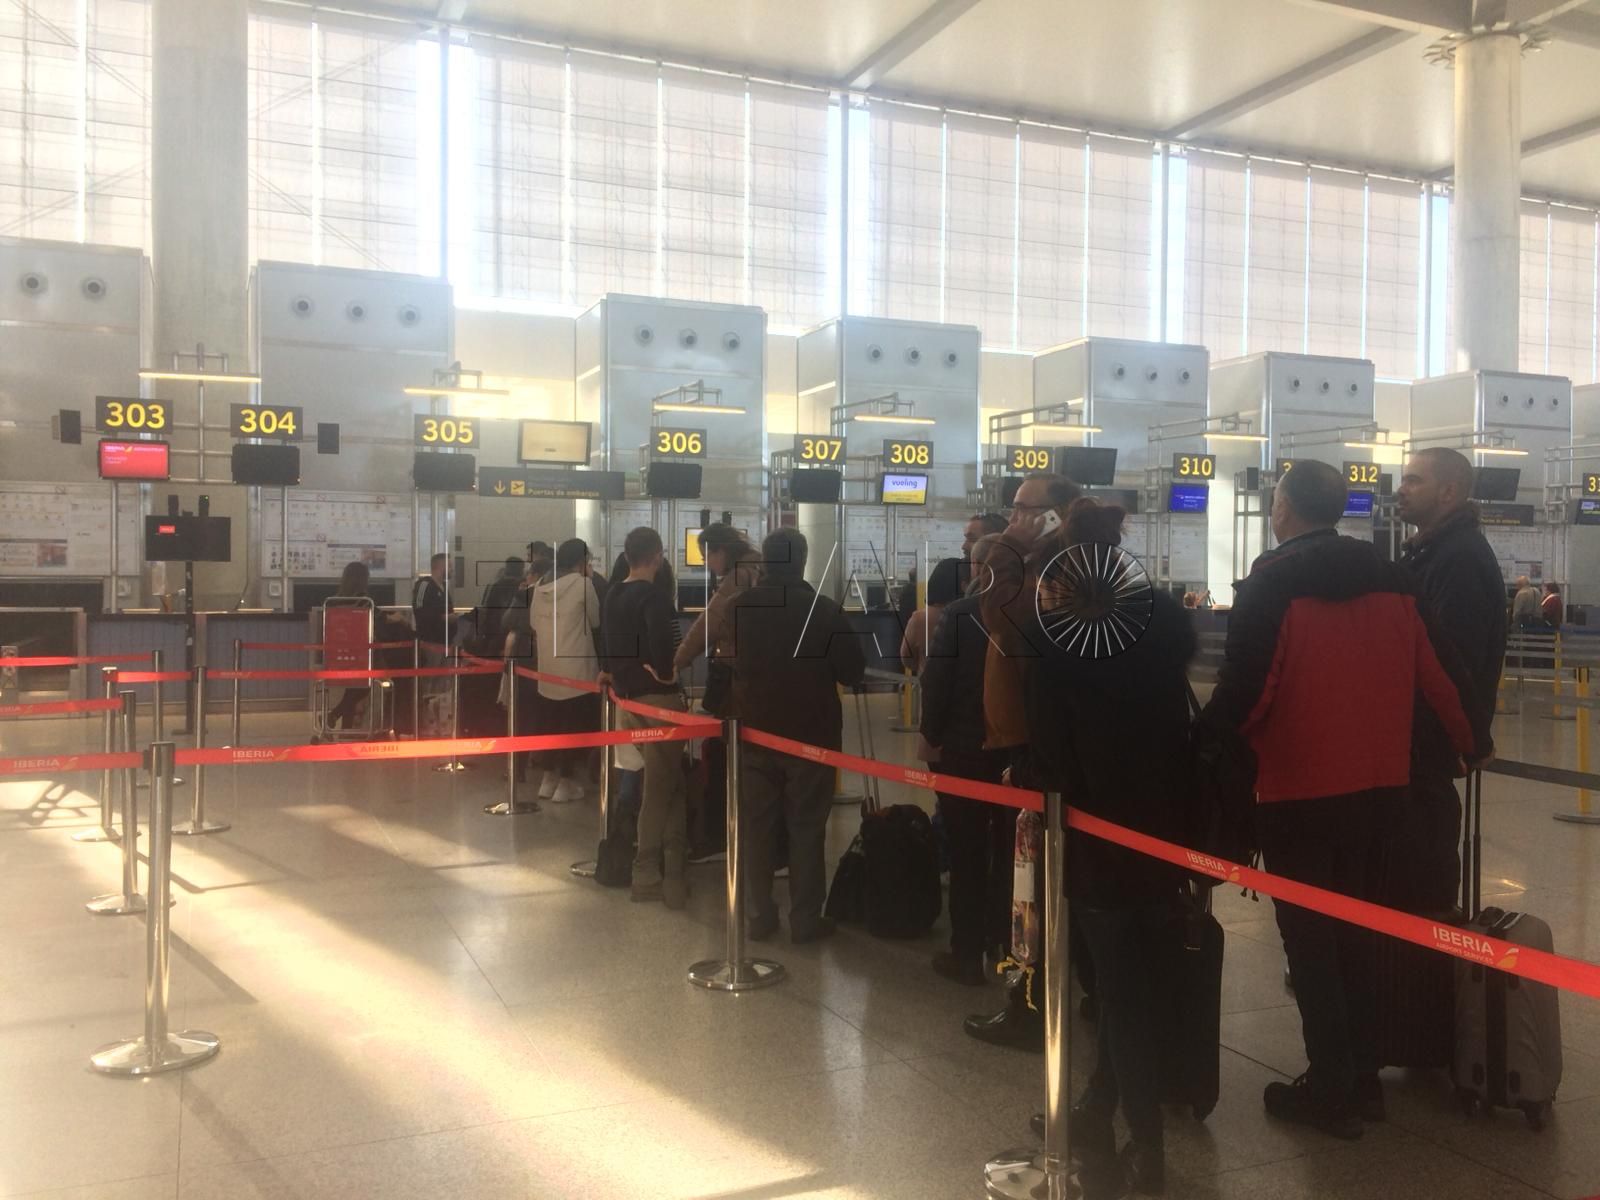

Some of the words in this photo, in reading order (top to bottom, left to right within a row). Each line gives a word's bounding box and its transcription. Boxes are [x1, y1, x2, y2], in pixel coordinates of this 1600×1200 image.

[105, 402, 165, 429] 303
[240, 409, 296, 435] 304
[423, 419, 473, 443] 305
[657, 431, 702, 454] 306
[801, 439, 842, 461] 307
[890, 443, 929, 465] 308
[1013, 449, 1049, 469] 309
[1180, 456, 1213, 476] 310
[1349, 464, 1378, 483] 312
[891, 478, 918, 489] vueling
[631, 729, 664, 739] IBERIA
[13, 758, 60, 769] IBERIA
[232, 749, 274, 759] IBERIA
[904, 768, 928, 783] IBERIA
[1186, 851, 1226, 873] IBERIA
[1433, 926, 1495, 956] IBERIA
